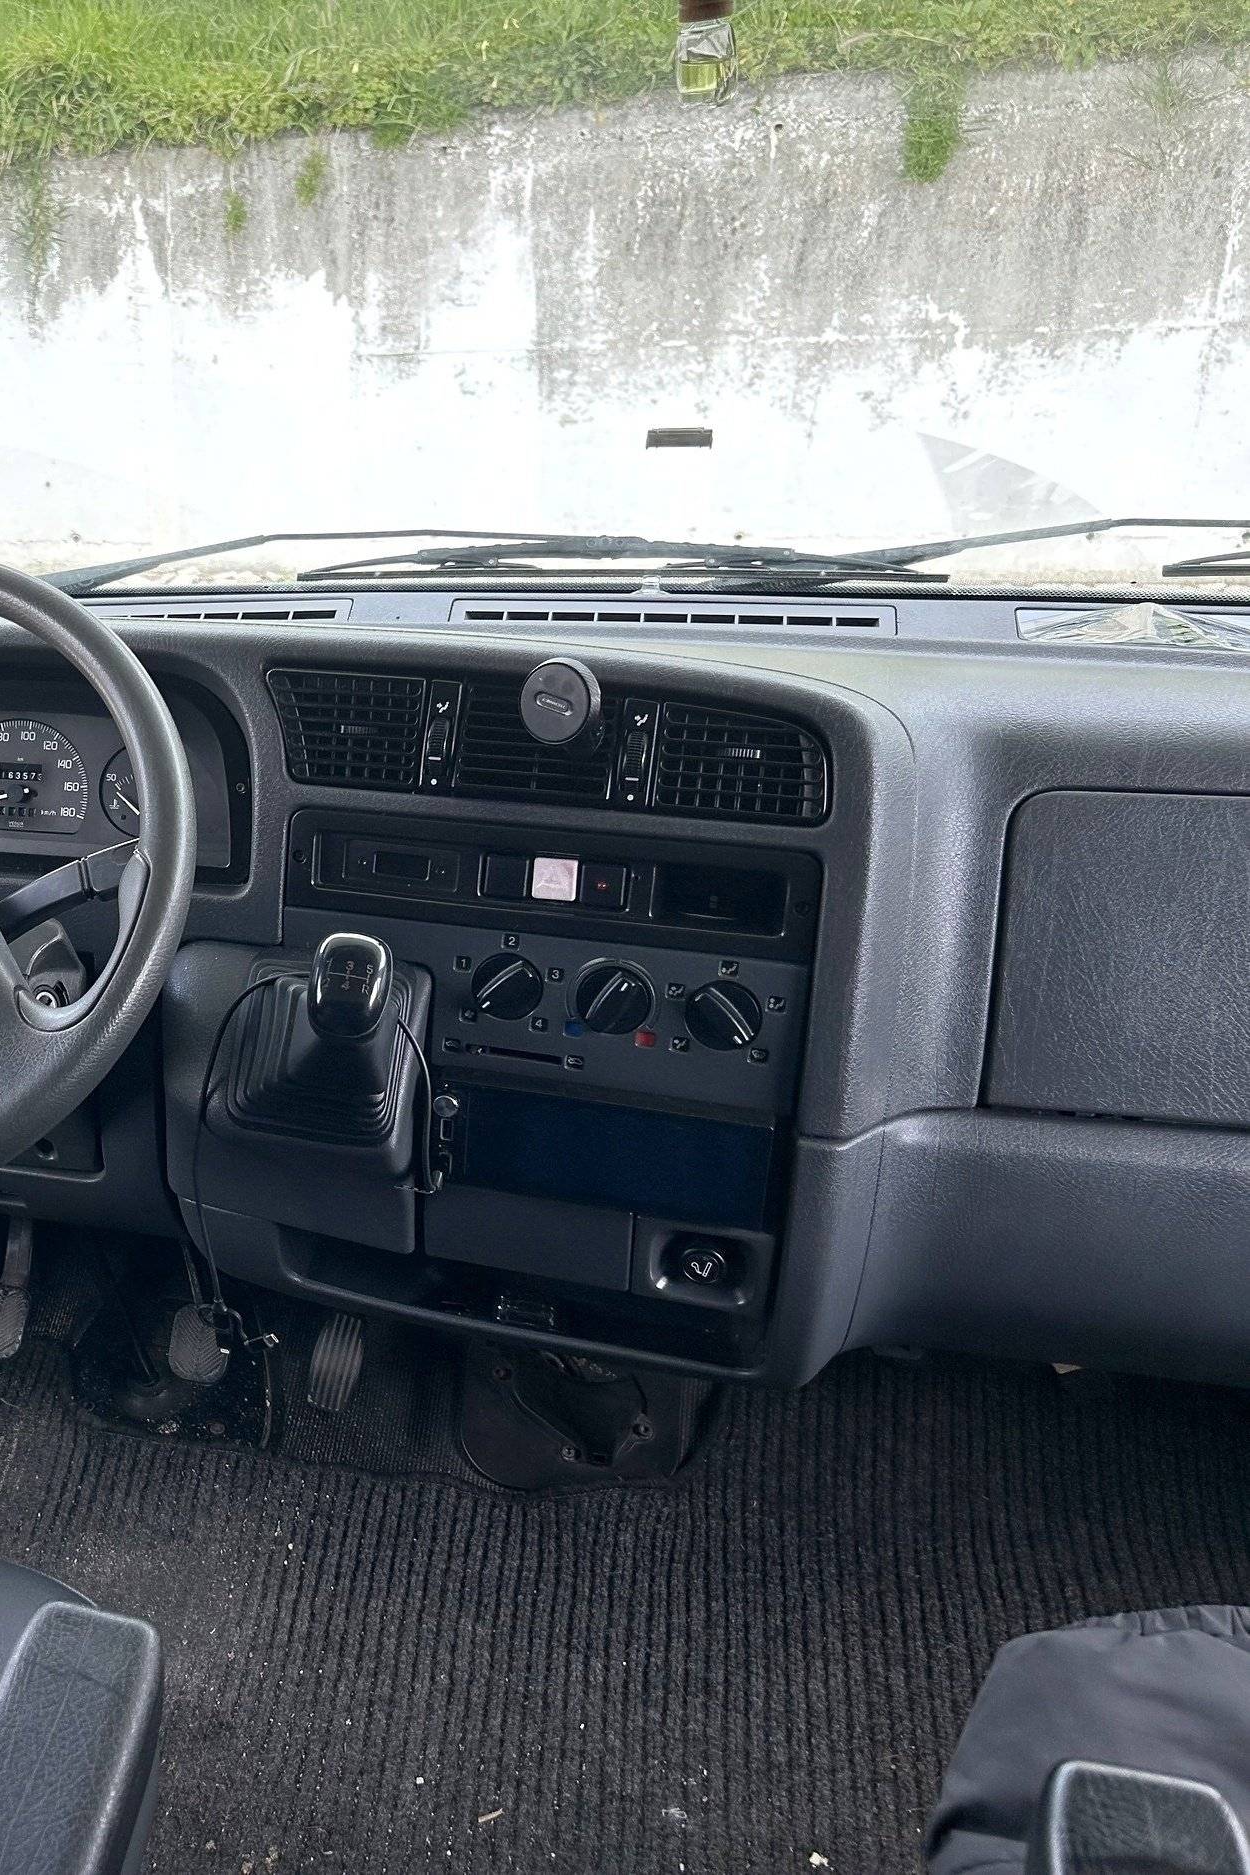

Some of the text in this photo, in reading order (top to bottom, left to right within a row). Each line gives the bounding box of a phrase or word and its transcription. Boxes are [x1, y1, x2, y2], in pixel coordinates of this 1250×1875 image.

[20, 731, 35, 741] 100
[43, 741, 58, 750] 120
[57, 759, 72, 769] 140
[106, 773, 117, 781] 50
[64, 782, 79, 791] 160
[60, 807, 75, 817] 180
[508, 936, 516, 946] 2
[346, 960, 354, 971] 3
[461, 959, 466, 967] 1
[366, 964, 373, 975] 5
[551, 969, 560, 979] 3
[535, 1019, 543, 1028] 4
